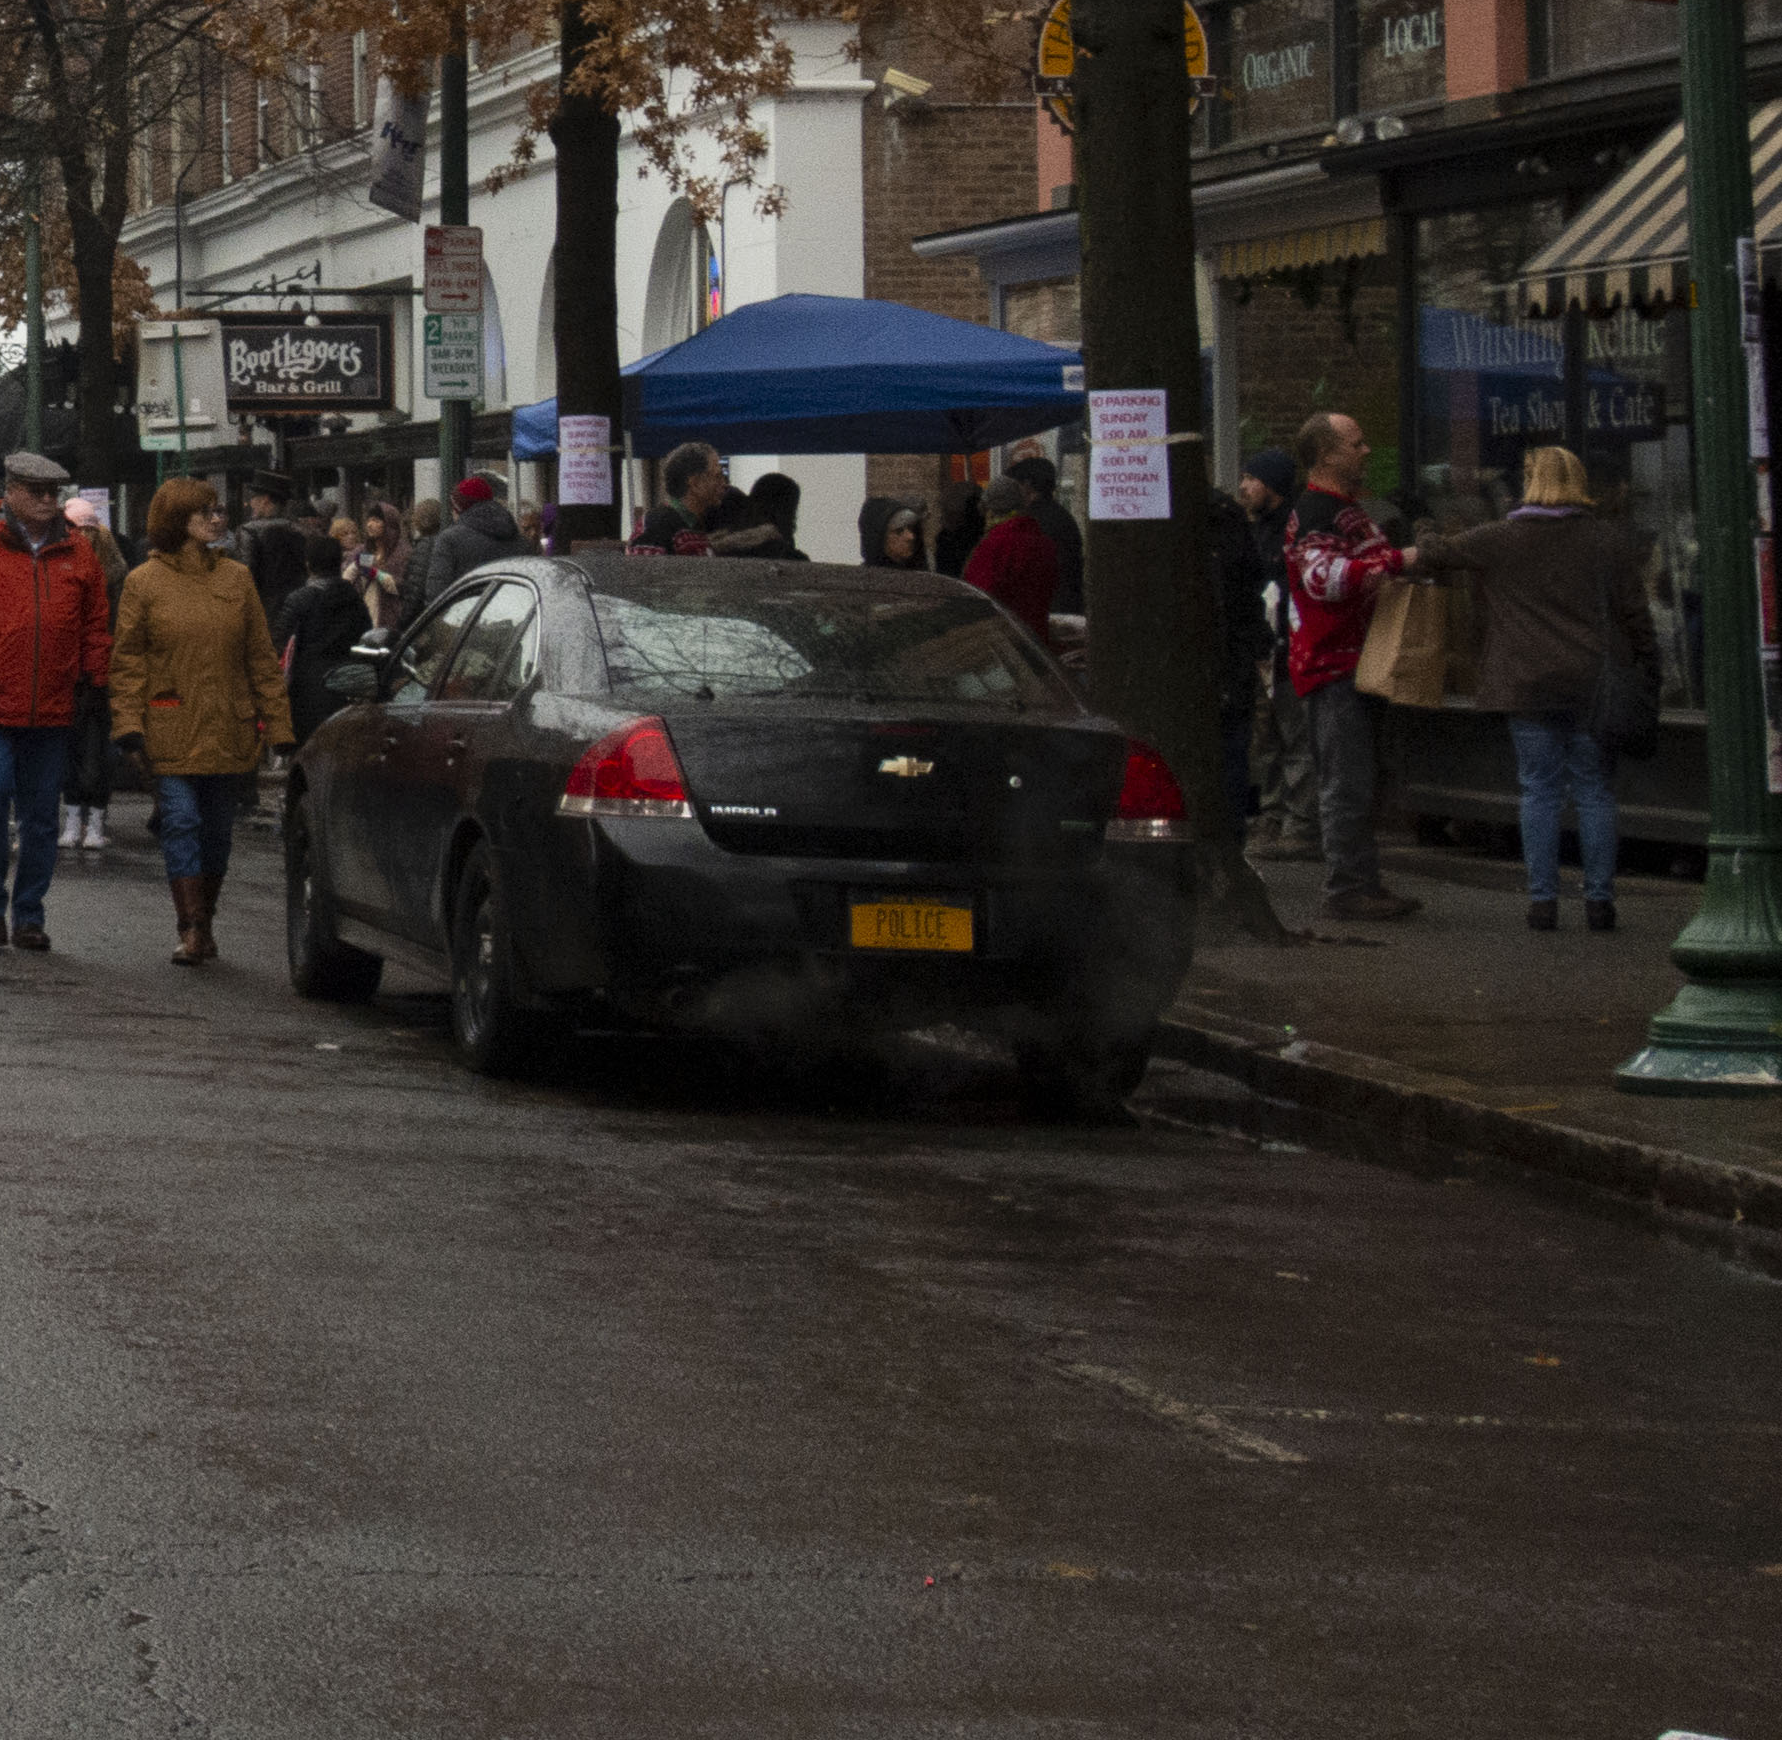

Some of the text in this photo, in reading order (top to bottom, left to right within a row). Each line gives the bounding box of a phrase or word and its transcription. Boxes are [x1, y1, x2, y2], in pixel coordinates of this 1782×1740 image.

[1383, 10, 1442, 58] LOCAL
[1242, 41, 1316, 91] ORGANIC
[427, 319, 441, 345] 2
[1587, 310, 1666, 359] Kettle
[229, 332, 362, 386] Bootlegger's
[1451, 315, 1565, 380] Whistling
[255, 379, 341, 394] Bar & Grill
[1105, 395, 1161, 407] PARKING
[1099, 412, 1149, 424] SUNDAY
[1489, 396, 1521, 435] Tea
[1127, 429, 1148, 439] AM
[1127, 455, 1148, 466] PM
[1099, 486, 1149, 497] STROLL
[710, 805, 778, 817] IMPALA
[876, 909, 948, 940] POLICE
